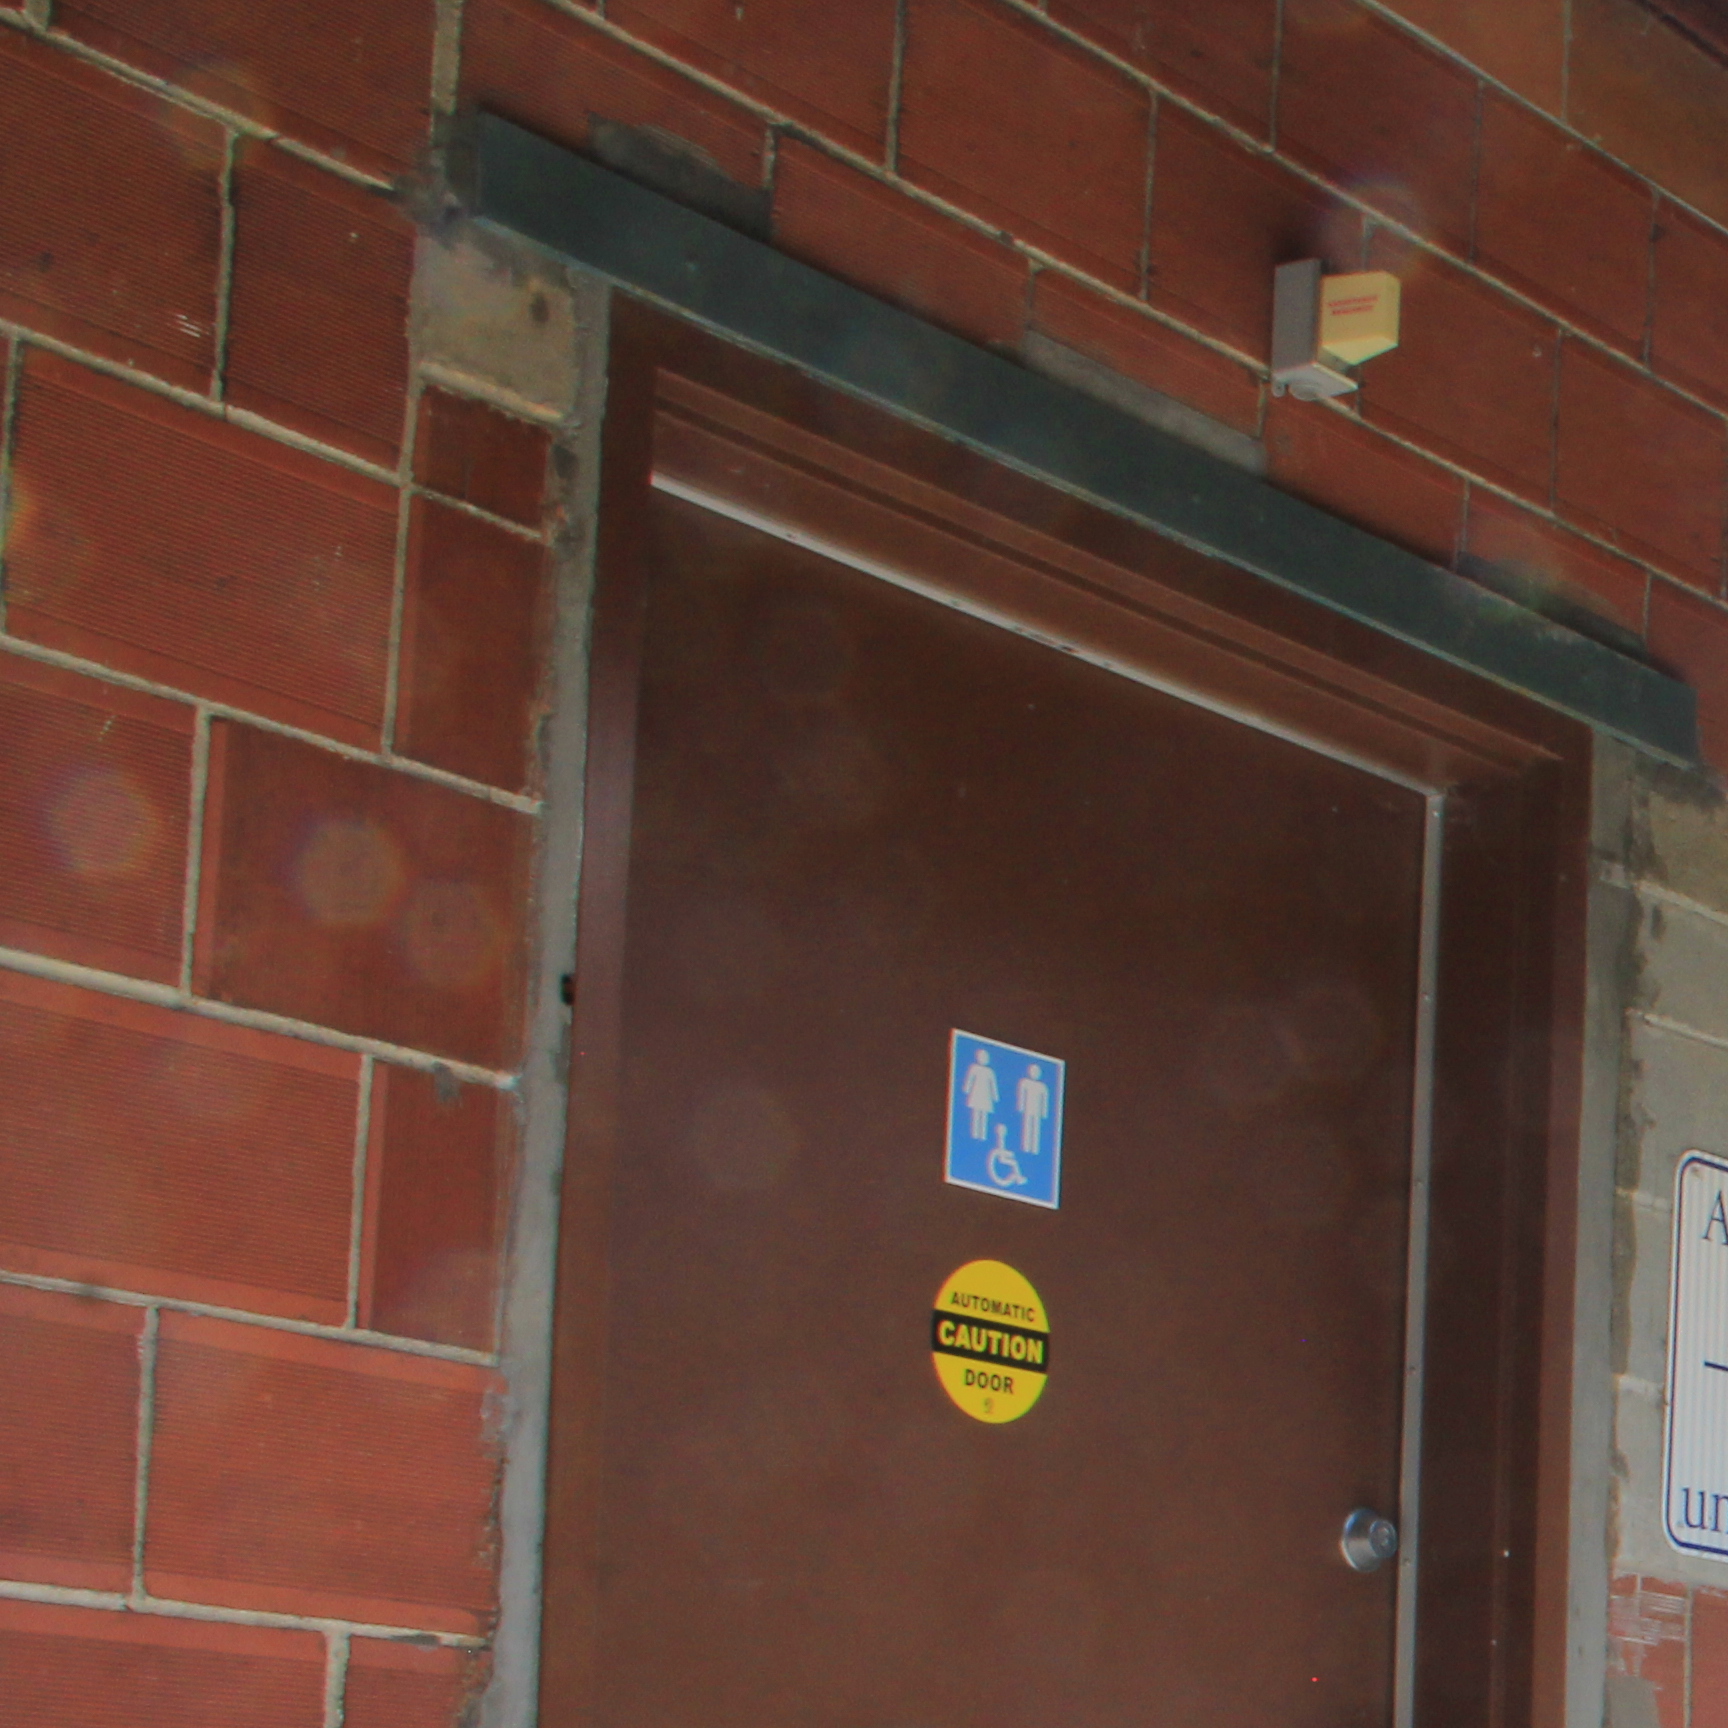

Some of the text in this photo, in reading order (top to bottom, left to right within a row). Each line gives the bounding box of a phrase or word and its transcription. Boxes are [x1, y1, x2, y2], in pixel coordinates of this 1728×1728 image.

[951, 1291, 1035, 1322] AUTOMATIC
[937, 1320, 1043, 1364] CAUTION
[964, 1369, 1013, 1394] DOOR
